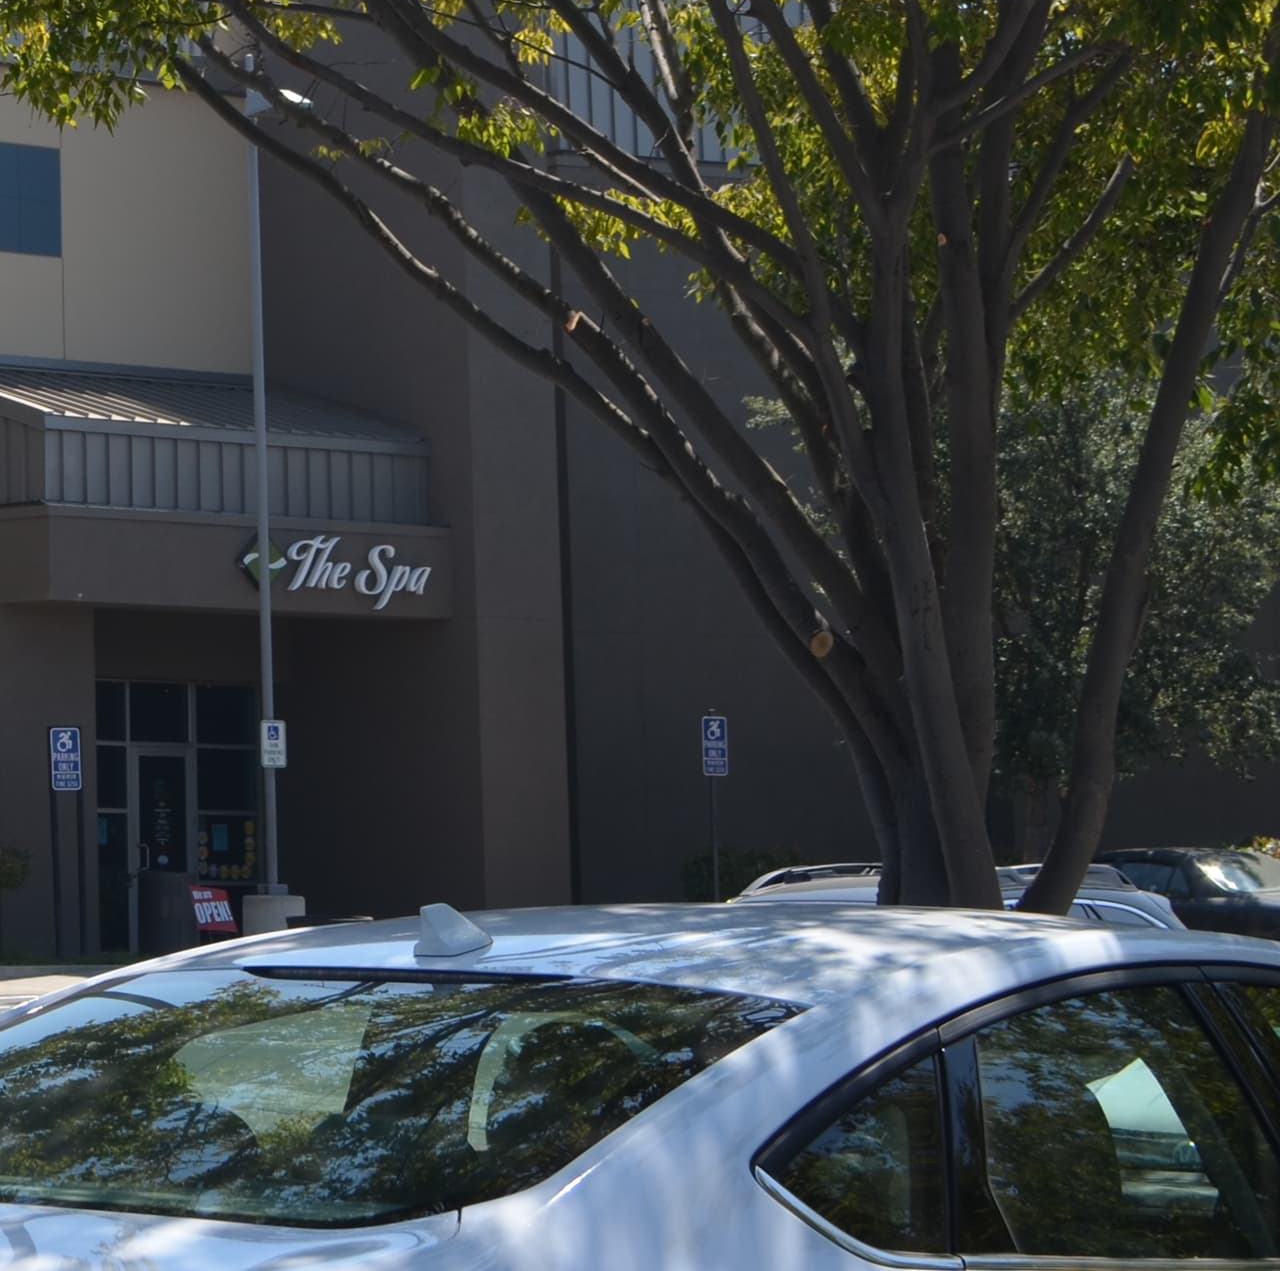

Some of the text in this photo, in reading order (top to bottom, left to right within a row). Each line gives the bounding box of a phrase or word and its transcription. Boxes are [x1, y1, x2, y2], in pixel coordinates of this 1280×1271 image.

[287, 535, 432, 610] The Spa
[194, 900, 234, 924] OPEN!
